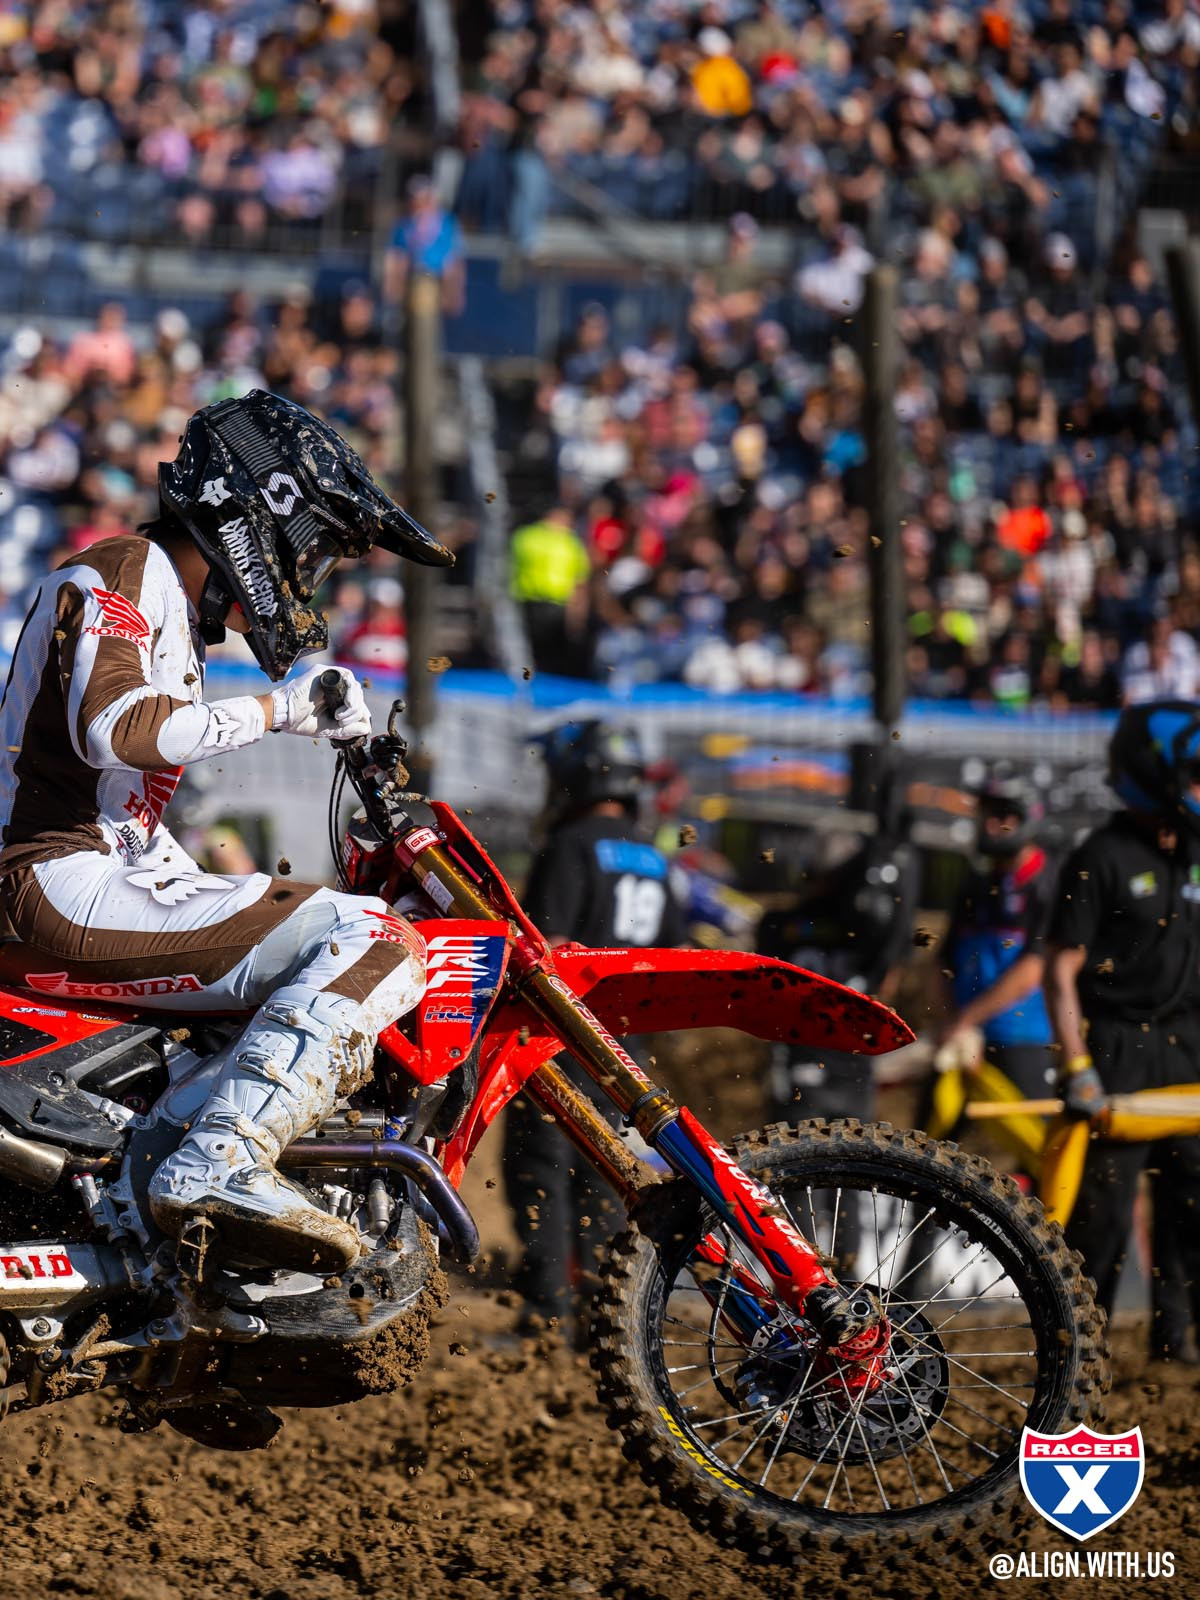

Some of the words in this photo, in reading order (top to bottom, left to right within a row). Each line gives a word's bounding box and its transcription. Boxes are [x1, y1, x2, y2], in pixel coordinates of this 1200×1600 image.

[218, 517, 261, 570] DRINK
[243, 566, 278, 618] WEIRD
[84, 625, 149, 652] HONDA
[410, 832, 433, 848] GET
[64, 976, 204, 998] HONDA
[424, 1005, 477, 1021] HRC
[575, 1005, 651, 1082] SHOWA
[708, 1145, 816, 1256] DUNOP
[0, 1254, 75, 1280] DID
[658, 1406, 745, 1491] DUNLOP
